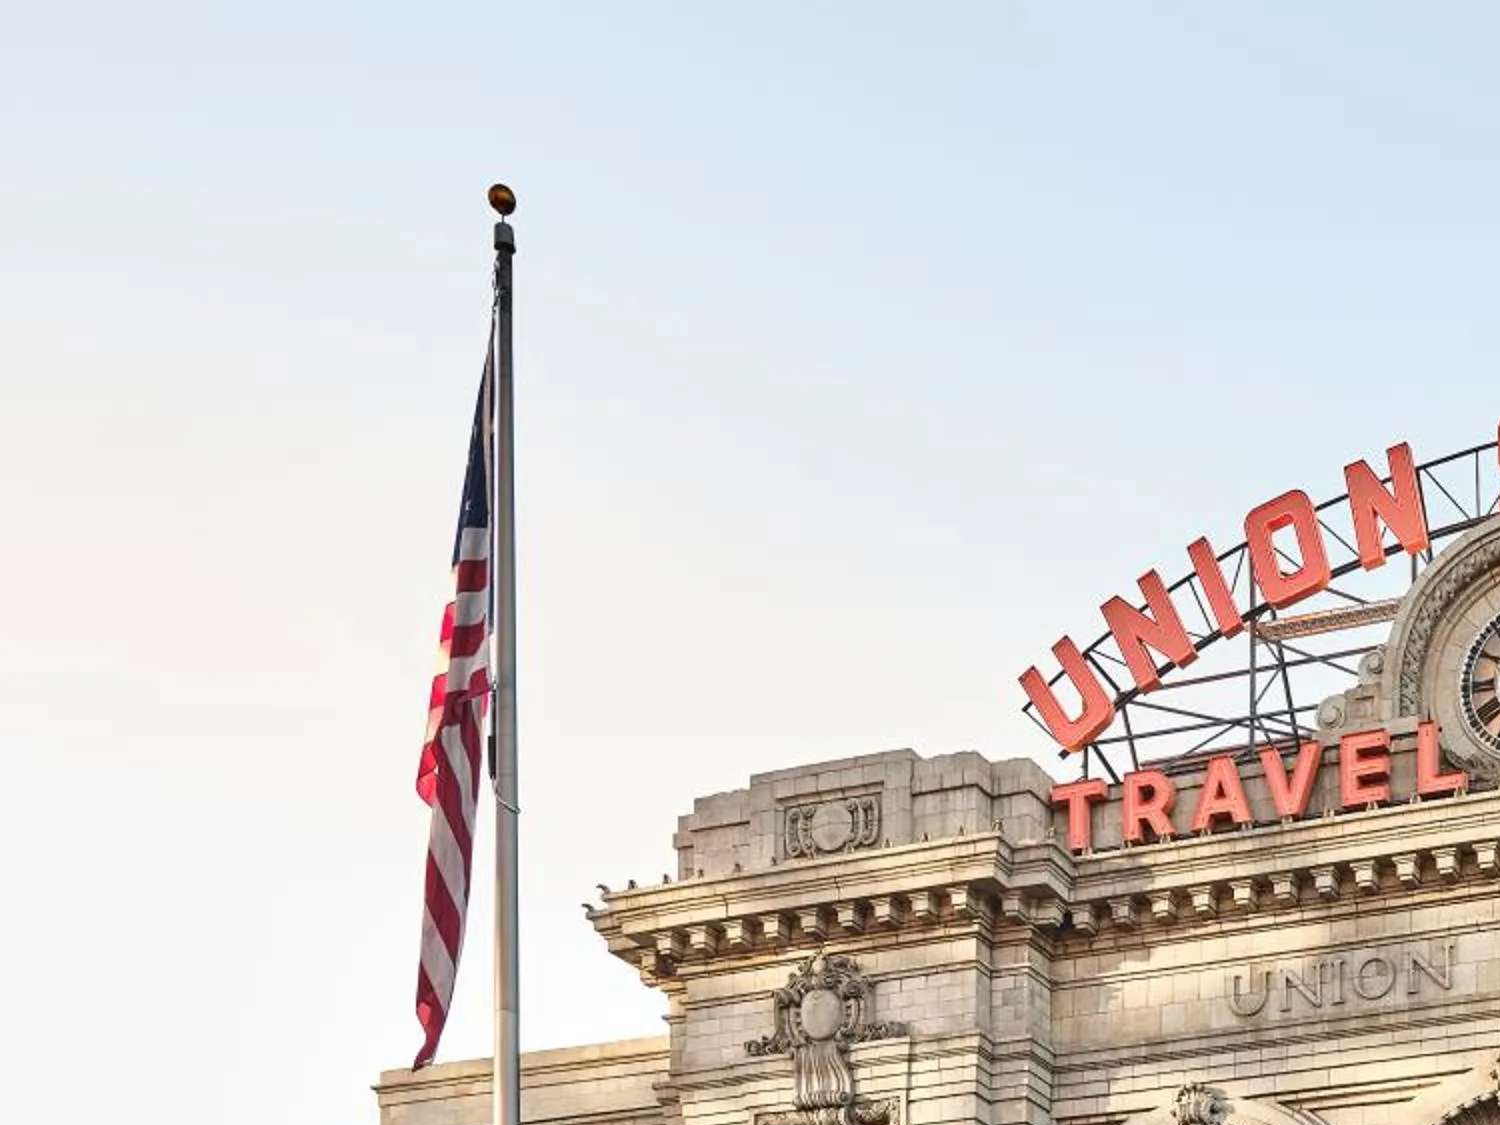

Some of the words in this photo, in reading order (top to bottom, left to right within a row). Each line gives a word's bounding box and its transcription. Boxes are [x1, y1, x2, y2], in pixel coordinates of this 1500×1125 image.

[1018, 441, 1431, 752] UNION
[1051, 720, 1468, 855] TRAVEL
[1224, 944, 1458, 1018] UNION
